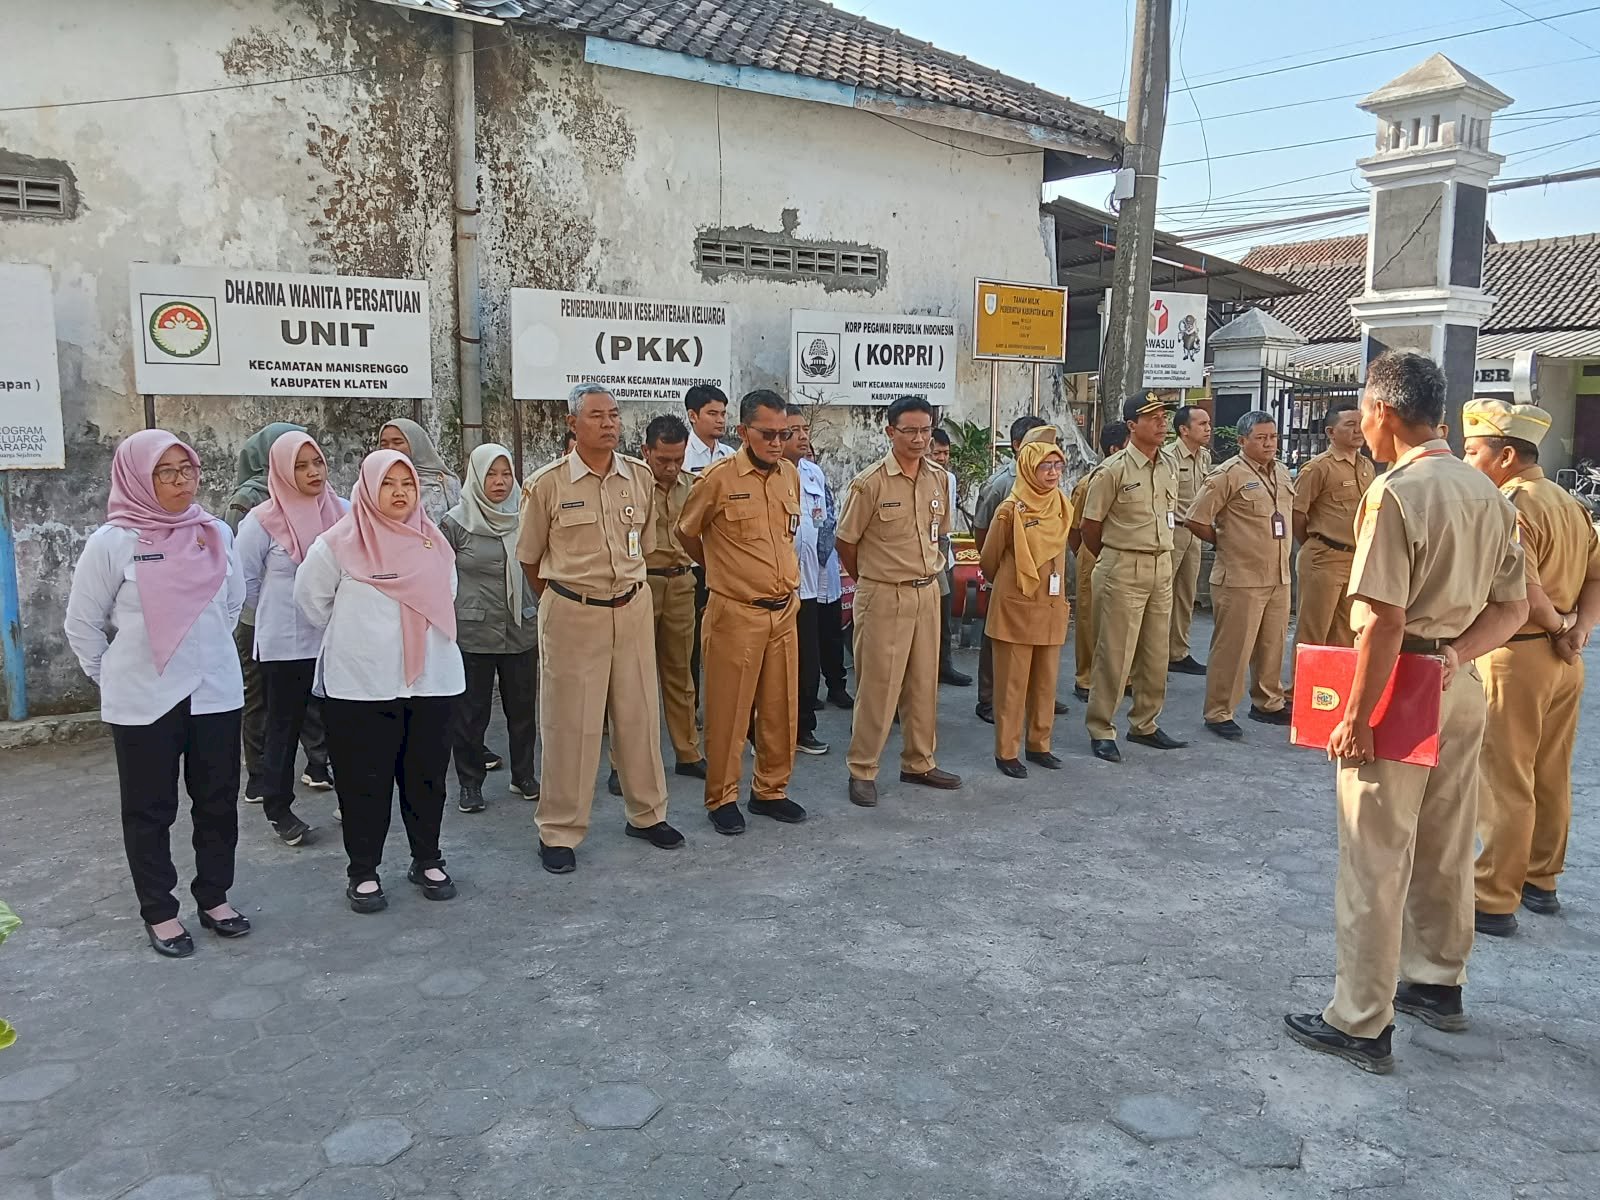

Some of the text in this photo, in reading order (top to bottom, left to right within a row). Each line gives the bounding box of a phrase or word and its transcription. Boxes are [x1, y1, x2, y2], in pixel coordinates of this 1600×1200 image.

[225, 279, 422, 314] DHARMA WANITA PERSATUAN
[561, 298, 726, 326] PEMBERDAYAAN DAN KESEJAHTERAAN KELUARGA
[281, 319, 375, 348] UNIT
[844, 321, 954, 336] KORP PEGAWAI REPUBLIK INDONESIA
[595, 331, 703, 367] (PKK)
[249, 360, 409, 374] KECAMATAN MANISRENGGO
[566, 374, 580, 383] TIM
[581, 375, 626, 384] PENGGERAK
[627, 376, 670, 386] KECAMATAN
[1475, 368, 1512, 382] ER
[270, 377, 388, 390] KABUPATEN KLATEN
[852, 381, 867, 389] UNIT
[868, 381, 904, 389] KECAMATAN
[653, 390, 681, 399] KLATEN
[0, 426, 43, 435] OGRAM
